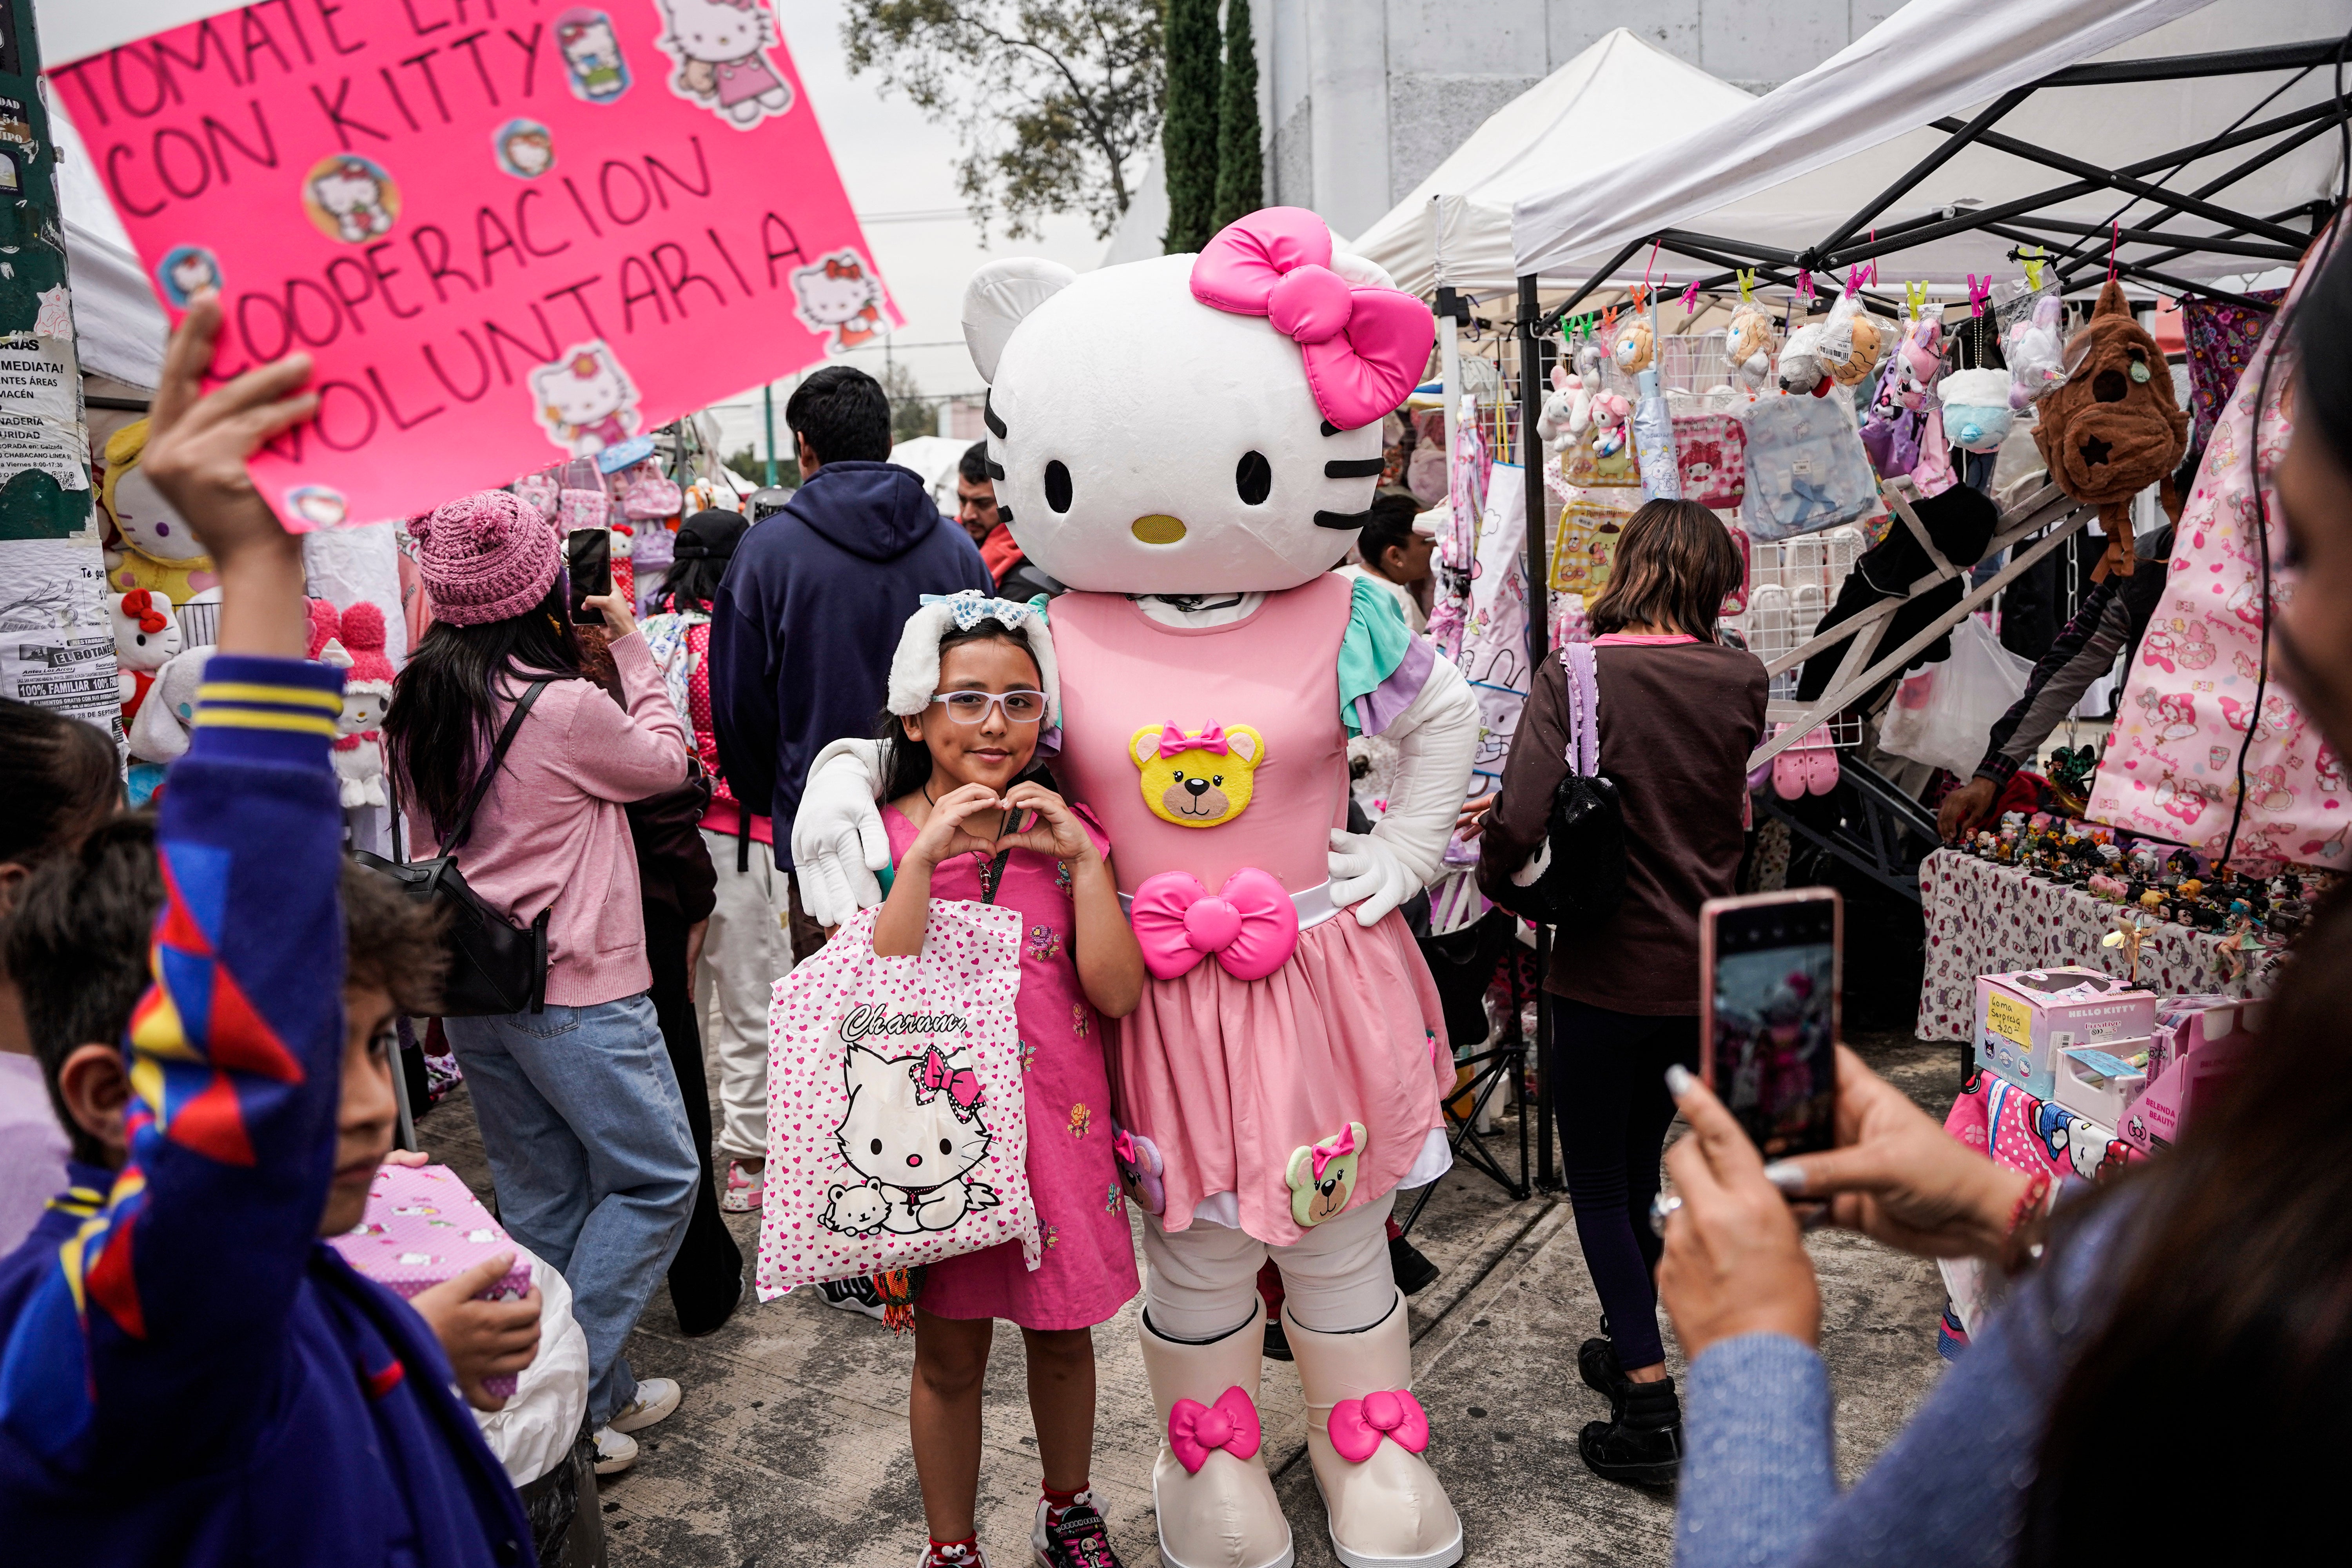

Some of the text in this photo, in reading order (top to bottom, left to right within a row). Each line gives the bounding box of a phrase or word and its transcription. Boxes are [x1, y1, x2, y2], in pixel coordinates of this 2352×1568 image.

[48, 0, 366, 126] TOMATE
[106, 22, 543, 218] CON KITTY
[0, 376, 58, 387] NTES ÁREAS
[81, 568, 92, 578] Te
[73, 637, 109, 646] RESTAURANTE
[54, 653, 74, 665] EL
[20, 684, 47, 697] 100%
[48, 682, 90, 694] FAMILIAR
[93, 677, 109, 690] 100%
[1992, 996, 2013, 1013] Goma
[2068, 1004, 2136, 1018] HELLO KITTY
[1991, 1008, 2020, 1026] Sorpresa
[2085, 1020, 2122, 1029] Creative
[1991, 1065, 2027, 1089] HELLO KITTY
[2146, 1097, 2175, 1118] BELENDA
[2149, 1110, 2175, 1128] BEAUTY
